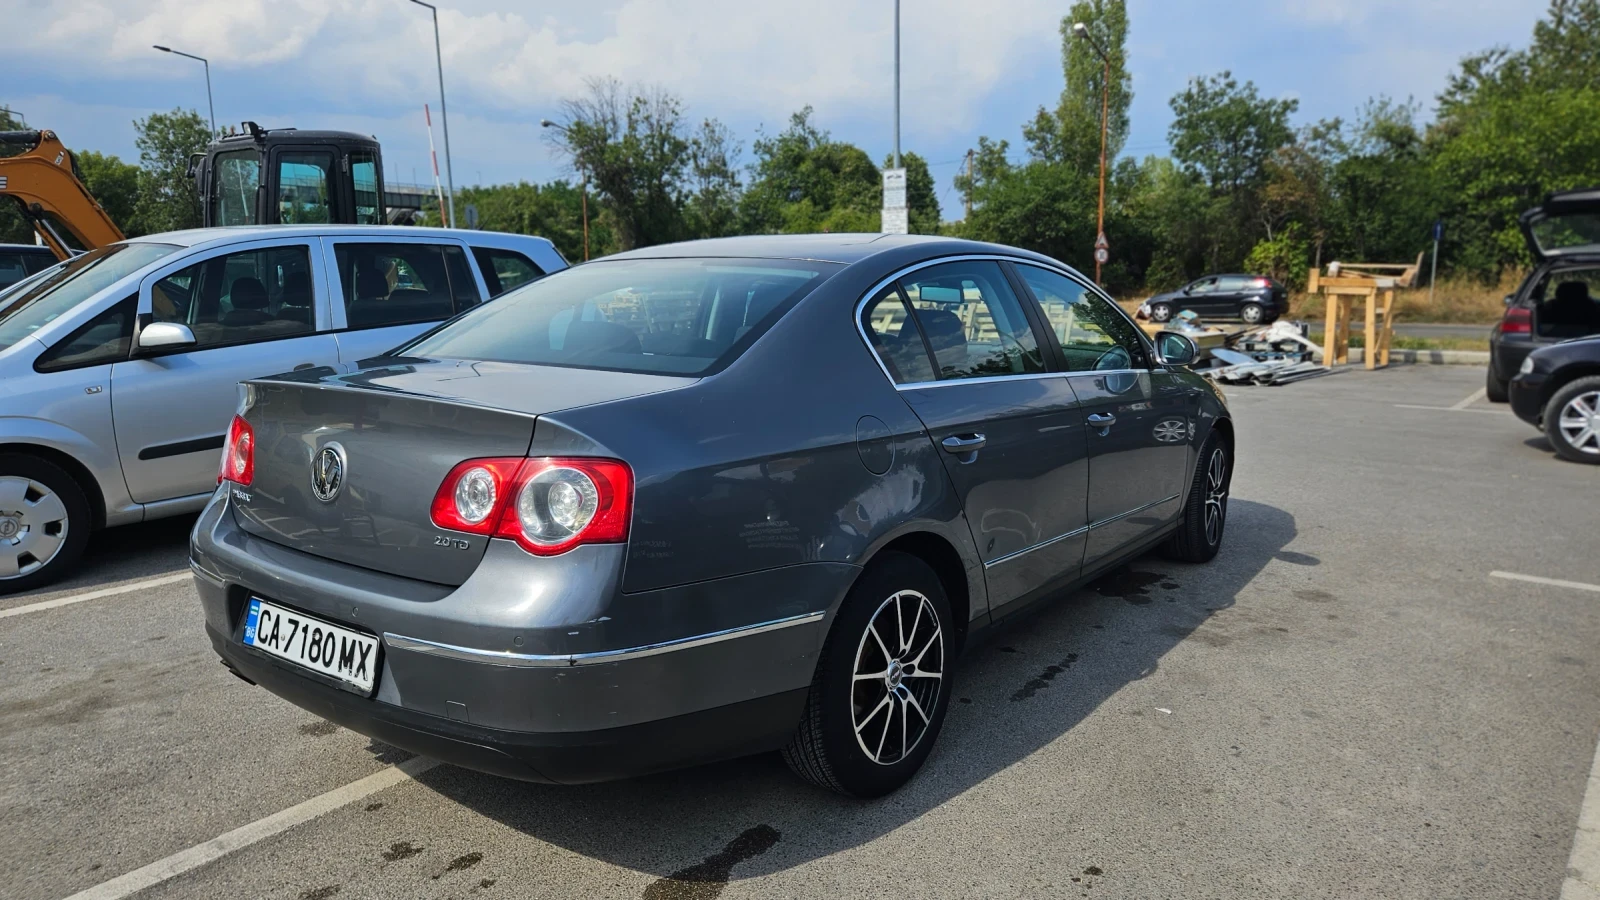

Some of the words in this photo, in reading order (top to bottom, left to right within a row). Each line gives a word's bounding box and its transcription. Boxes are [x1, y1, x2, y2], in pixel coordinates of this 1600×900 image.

[257, 609, 281, 650] CA
[283, 618, 337, 668] 7180
[338, 636, 373, 681] MX
